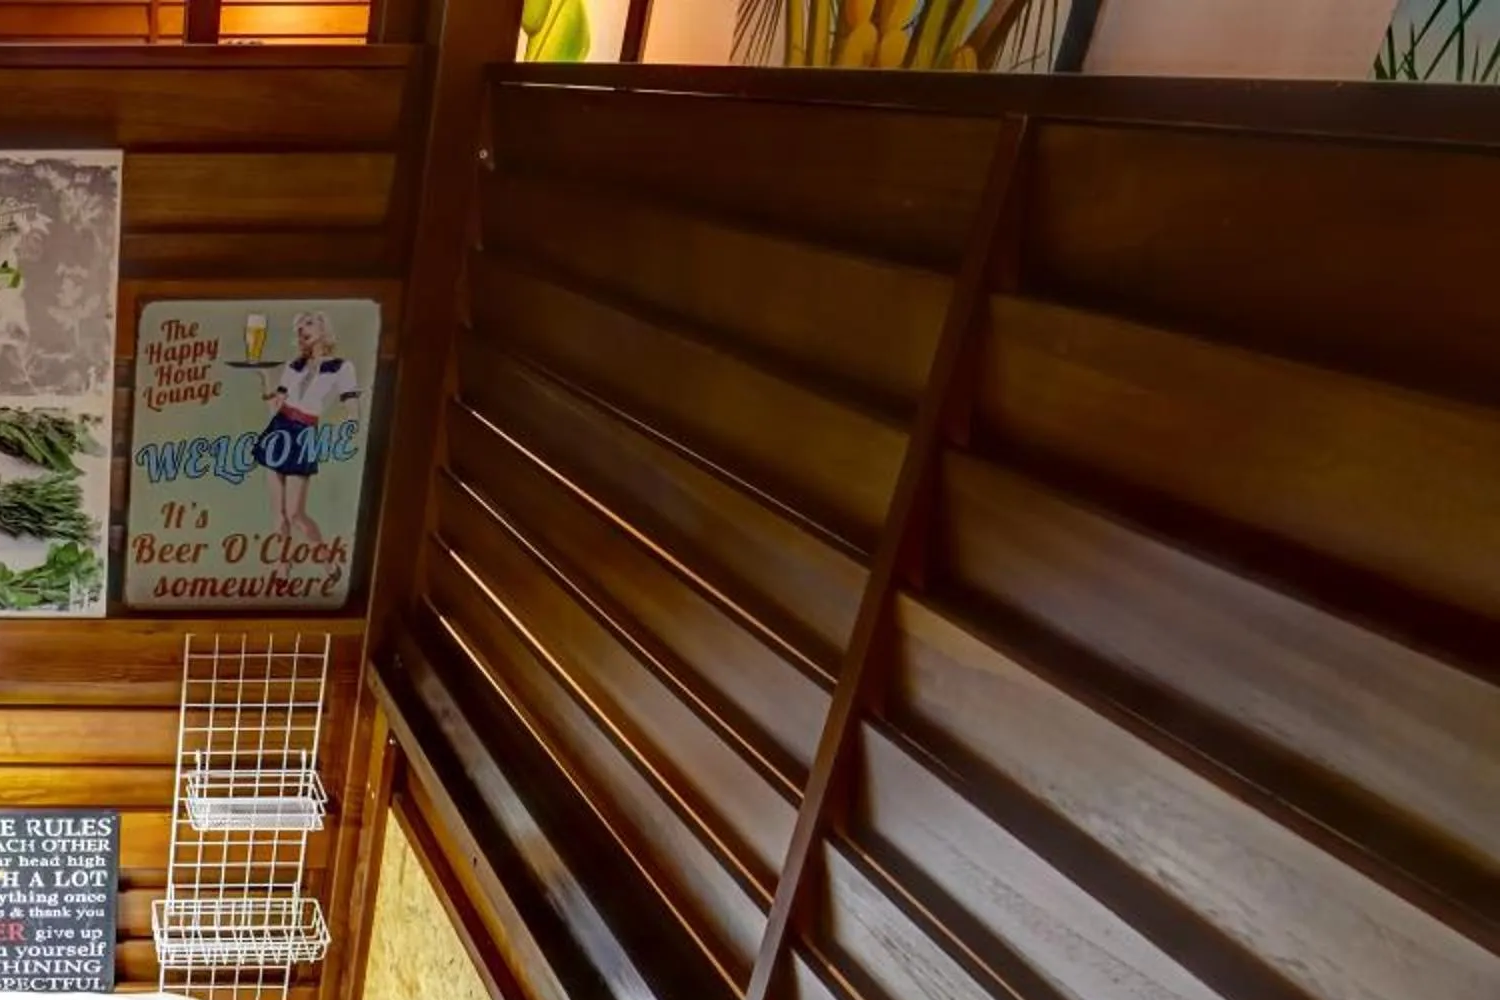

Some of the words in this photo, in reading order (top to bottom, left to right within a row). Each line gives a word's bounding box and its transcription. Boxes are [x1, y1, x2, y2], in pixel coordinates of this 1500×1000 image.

[161, 319, 199, 342] The
[145, 337, 219, 367] Happy
[154, 364, 211, 386] Hour
[143, 381, 222, 412] Lounge
[135, 420, 357, 484] WELCOME
[160, 501, 208, 528] It's
[132, 534, 208, 564] Beer
[221, 533, 348, 565] O'Clock
[153, 568, 339, 598] somewhere
[26, 818, 112, 837] RULES
[41, 838, 111, 853] OTHER
[19, 855, 60, 867] head
[67, 855, 106, 869] high
[29, 871, 44, 888] A
[55, 870, 108, 887] LOT
[63, 893, 107, 903] once
[10, 908, 25, 919] &
[29, 907, 72, 918] thank
[76, 908, 106, 920] you
[35, 926, 75, 942] give
[80, 928, 104, 940] up
[16, 942, 106, 959] yourself
